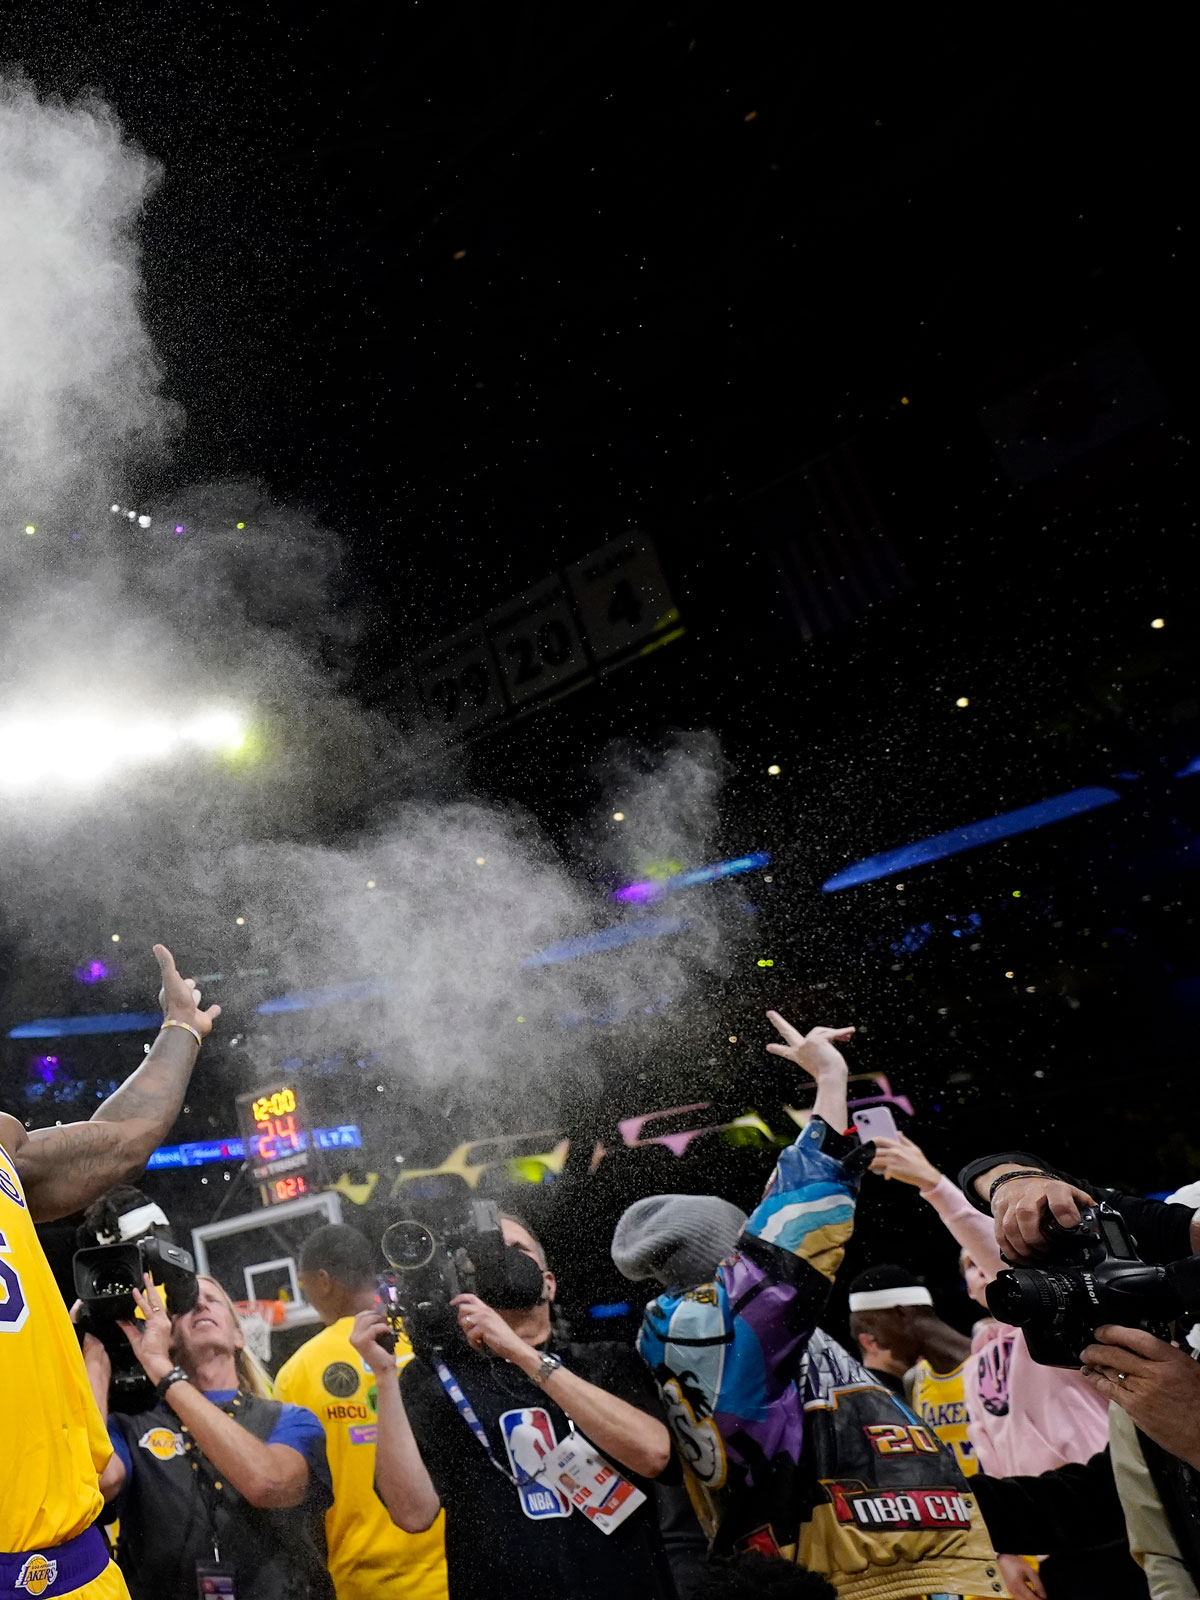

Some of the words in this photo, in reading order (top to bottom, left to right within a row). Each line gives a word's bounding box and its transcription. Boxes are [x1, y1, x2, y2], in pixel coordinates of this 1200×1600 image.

[607, 579, 642, 626] 4
[506, 620, 572, 686] 20
[252, 1089, 297, 1121] 12:00
[256, 1115, 299, 1159] 24
[327, 1406, 368, 1420] HBCU
[527, 1491, 555, 1513] NBA
[853, 1495, 922, 1524] NBA
[20, 1566, 56, 1586] LAKERS
